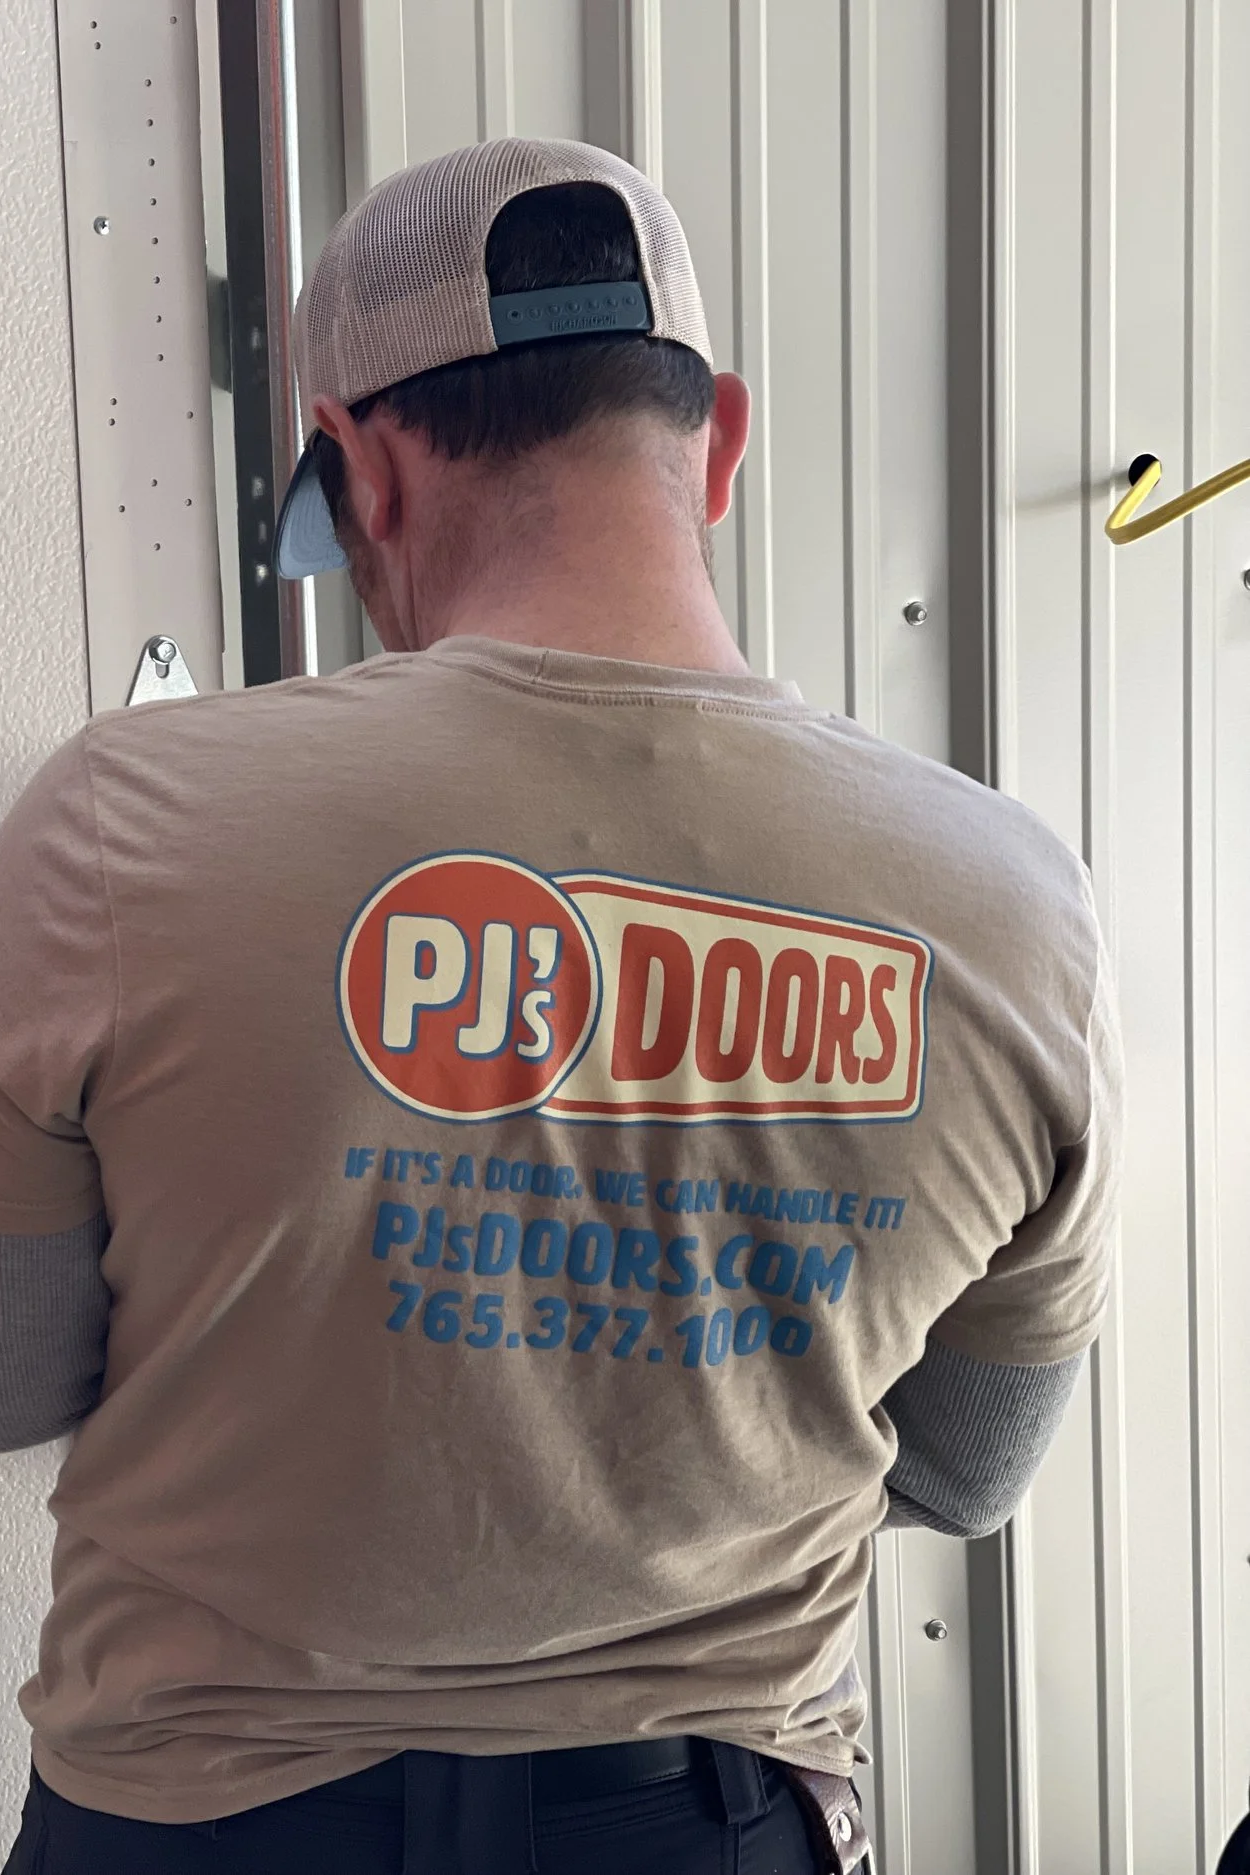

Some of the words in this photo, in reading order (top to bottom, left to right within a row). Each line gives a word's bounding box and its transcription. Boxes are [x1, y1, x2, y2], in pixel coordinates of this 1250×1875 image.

[610, 922, 897, 1085] DOORS
[345, 1147, 377, 1179] IF
[382, 1148, 442, 1185] IT'S
[450, 1154, 474, 1189] A
[596, 1168, 647, 1207] WE
[655, 1178, 720, 1214] CAN
[725, 1181, 860, 1225] HANDLE
[863, 1196, 907, 1230] IT!
[386, 1280, 814, 1368] 765.377.1000
